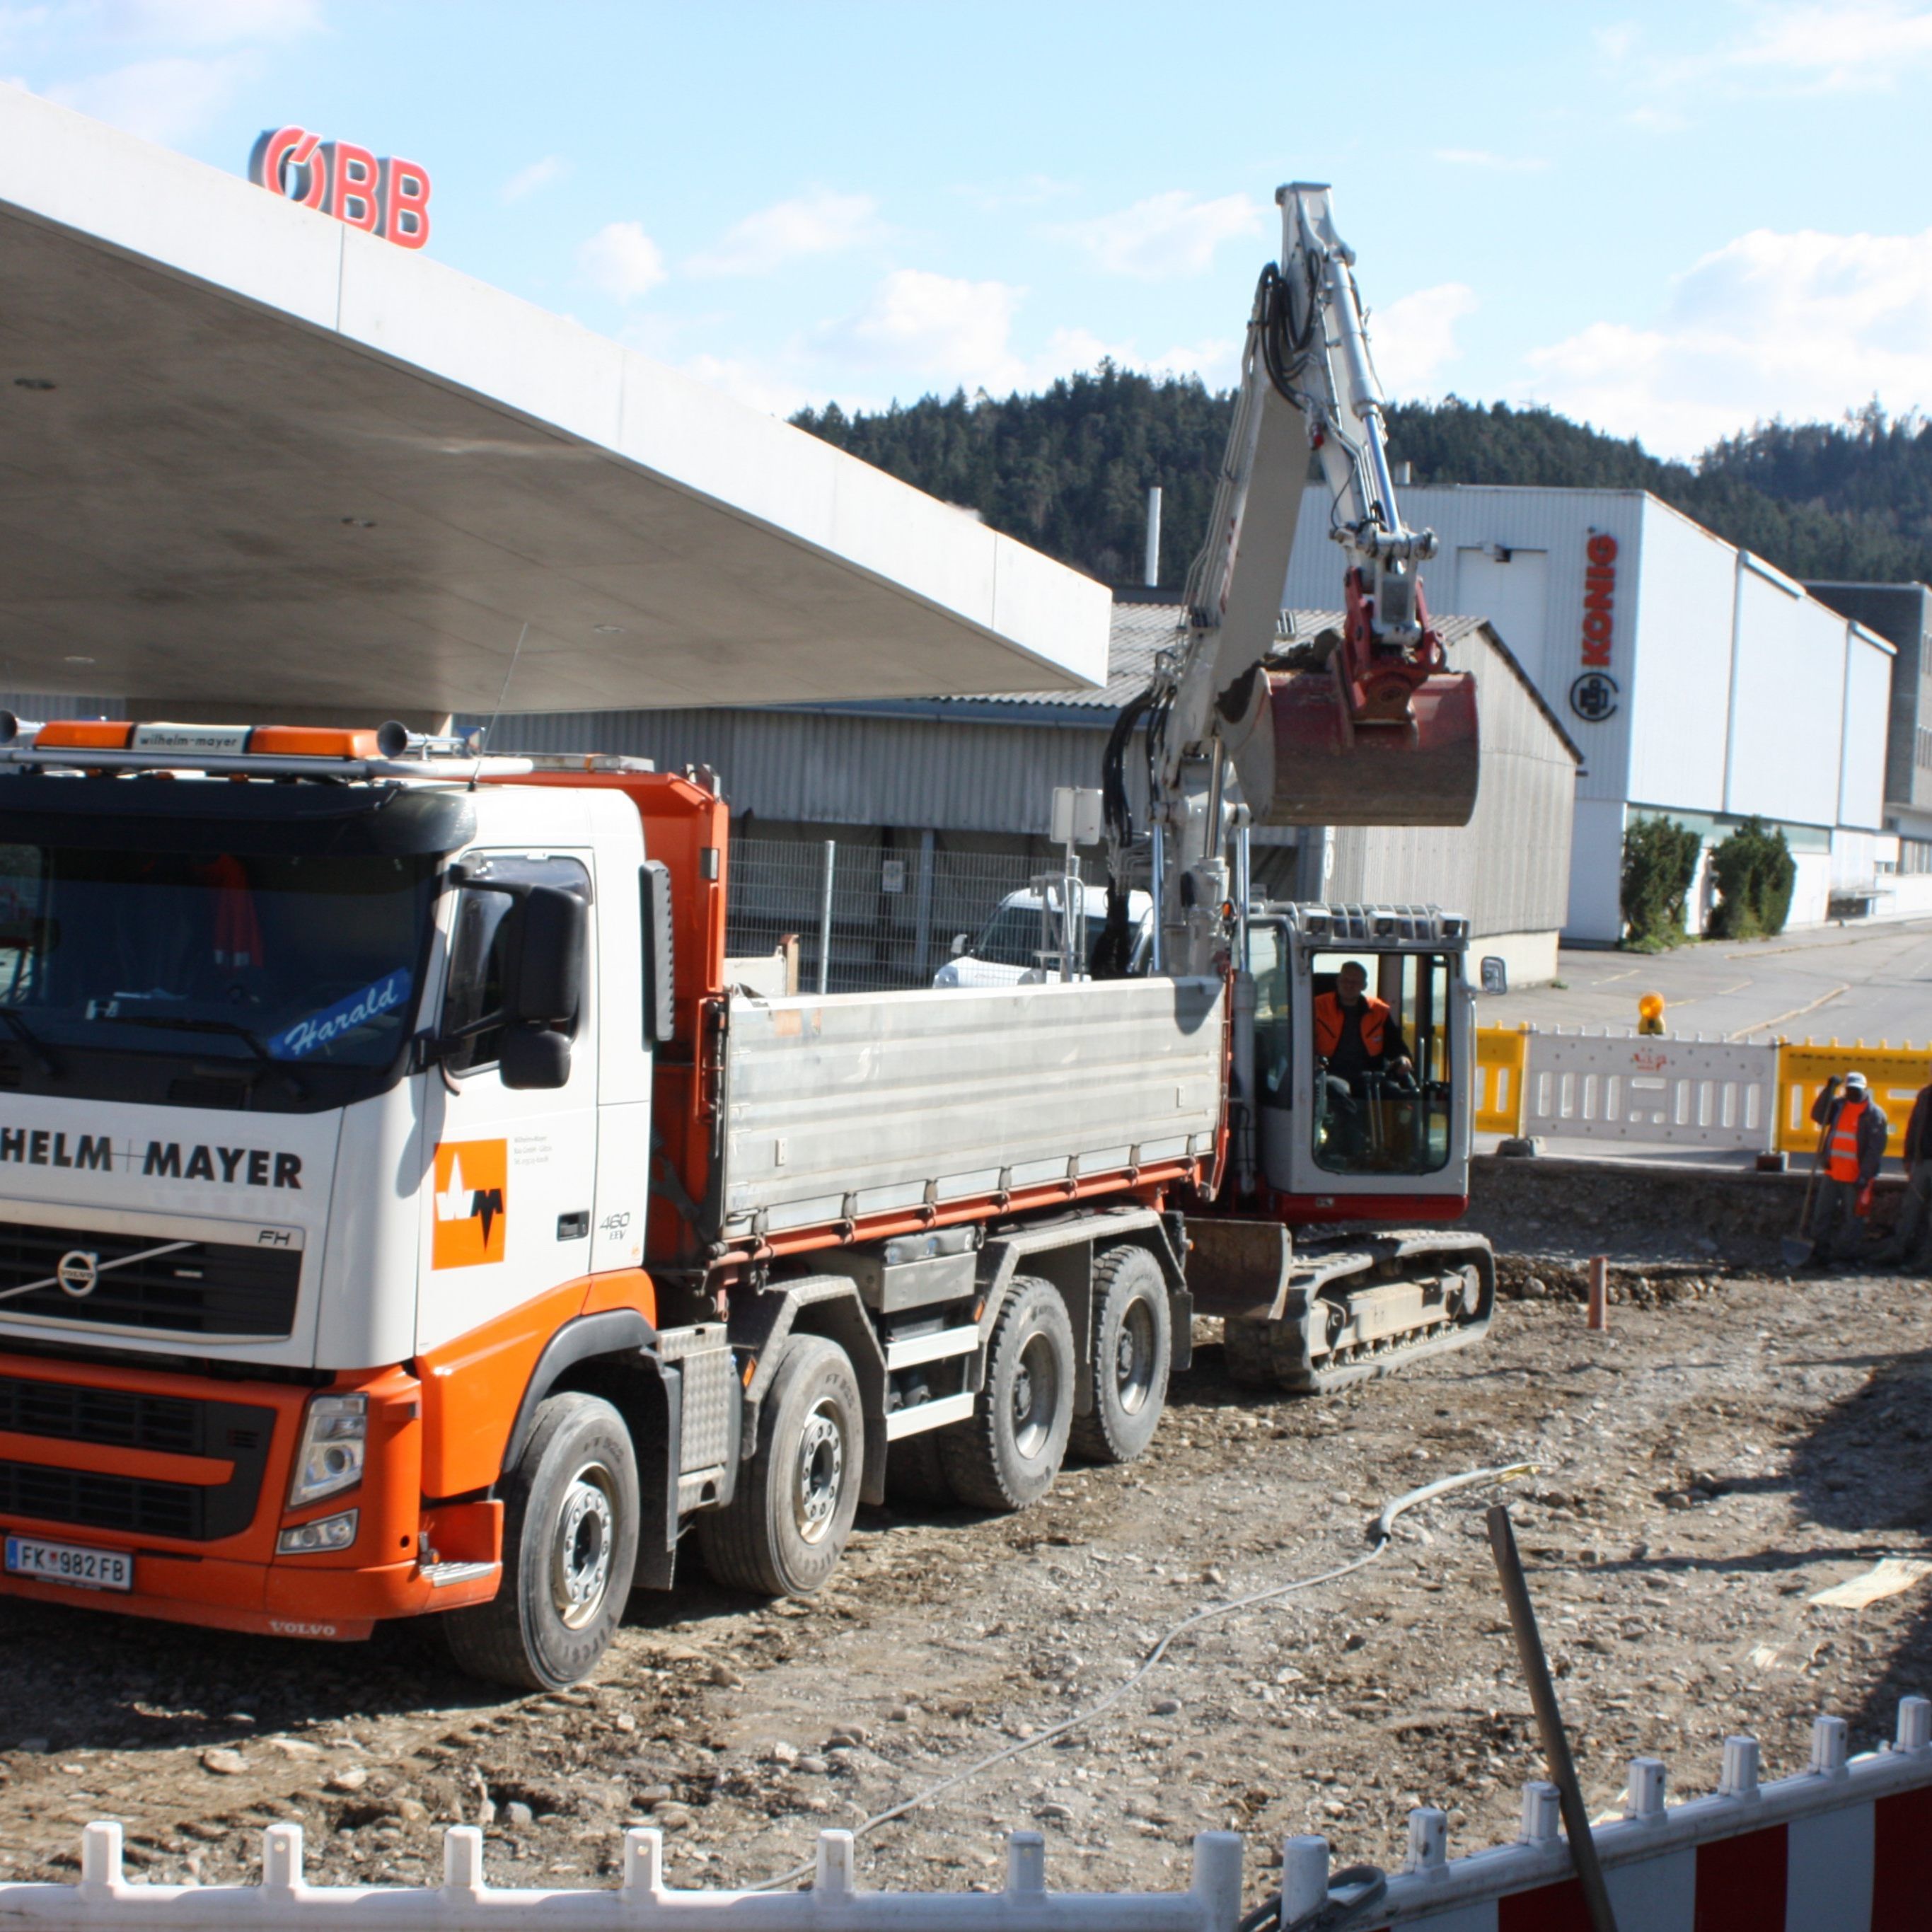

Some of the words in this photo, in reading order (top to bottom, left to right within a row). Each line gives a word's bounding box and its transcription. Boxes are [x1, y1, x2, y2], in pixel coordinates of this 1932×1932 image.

[284, 978, 398, 1055] Harald
[142, 1140, 302, 1190] MAYER
[598, 1211, 631, 1230] 460
[259, 1230, 291, 1246] FH
[22, 1545, 45, 1570] FK
[270, 1618, 336, 1636] VOLVO
